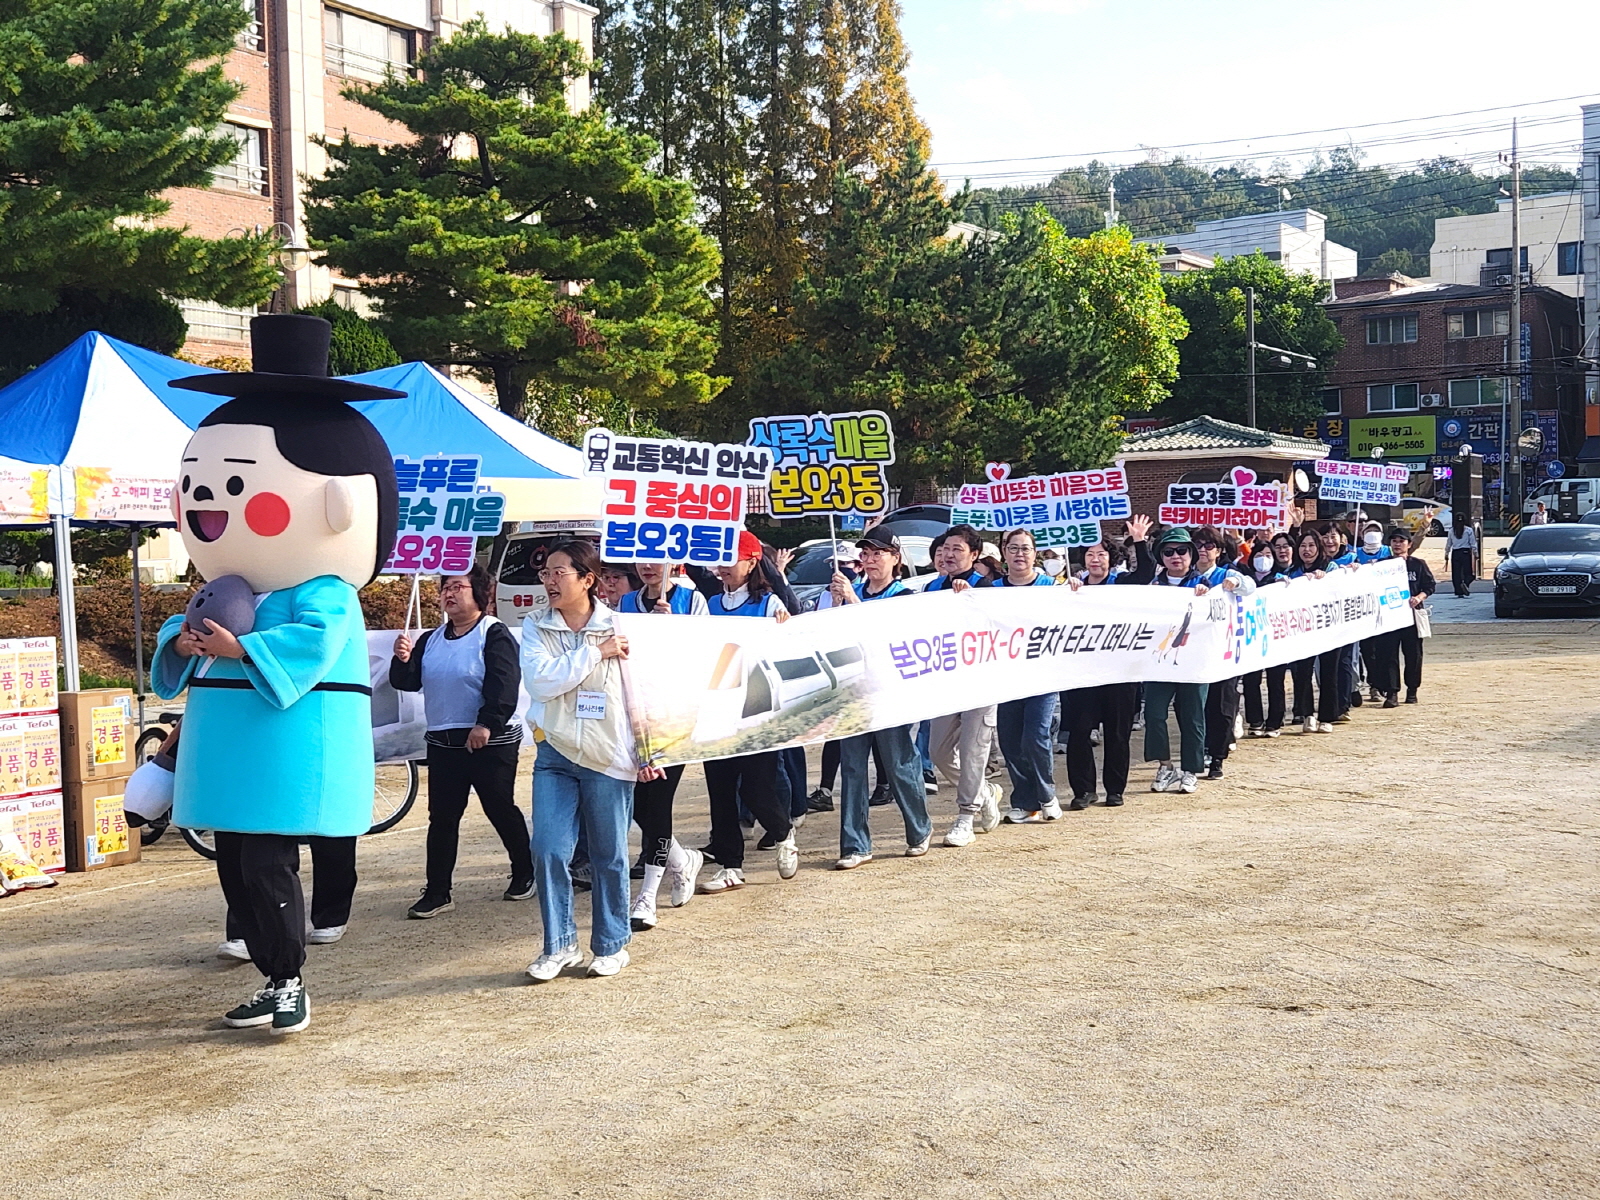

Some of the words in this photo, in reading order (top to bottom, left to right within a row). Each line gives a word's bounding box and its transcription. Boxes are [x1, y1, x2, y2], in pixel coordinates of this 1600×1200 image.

[1368, 426, 1412, 437] 바우광고
[1468, 422, 1500, 439] 간판
[612, 442, 709, 476] 교통혁신
[716, 449, 769, 480] 안산
[1317, 461, 1382, 479] 명품교육도시
[1385, 467, 1407, 481] 안산
[395, 459, 478, 493] 늘푸른
[1323, 477, 1350, 488] 최용신
[1352, 480, 1378, 491] 선생의
[770, 464, 883, 513] 본오3동
[991, 479, 1046, 503] 따뜻한
[1050, 471, 1124, 496] 마음으로
[1170, 487, 1236, 505] 본오3동
[1241, 488, 1278, 507] 완전
[1321, 487, 1364, 500] 살아숨쉬는
[1366, 492, 1397, 504] 본오3동
[606, 479, 637, 515] 그
[646, 480, 742, 521] 중심의
[443, 497, 503, 531] 마을
[953, 508, 993, 527] 늘푸
[993, 503, 1050, 527] 이웃을
[1055, 496, 1127, 521] 사랑하는
[605, 521, 735, 562] 본오3동!
[1030, 523, 1099, 546] 본오3동
[23, 640, 50, 649] Tefal
[889, 632, 957, 679] 본오3동
[961, 627, 1025, 665] GTX-C
[1026, 625, 1067, 659] 열차
[1062, 624, 1105, 654] 타고
[1100, 623, 1155, 652] 떠나는
[20, 670, 53, 689] 경품
[27, 719, 54, 728] Tefal
[95, 725, 122, 744] 경품
[24, 747, 57, 768] 경품
[30, 799, 57, 808] Tefal
[98, 814, 126, 835] 경품
[29, 827, 61, 848] 경품
